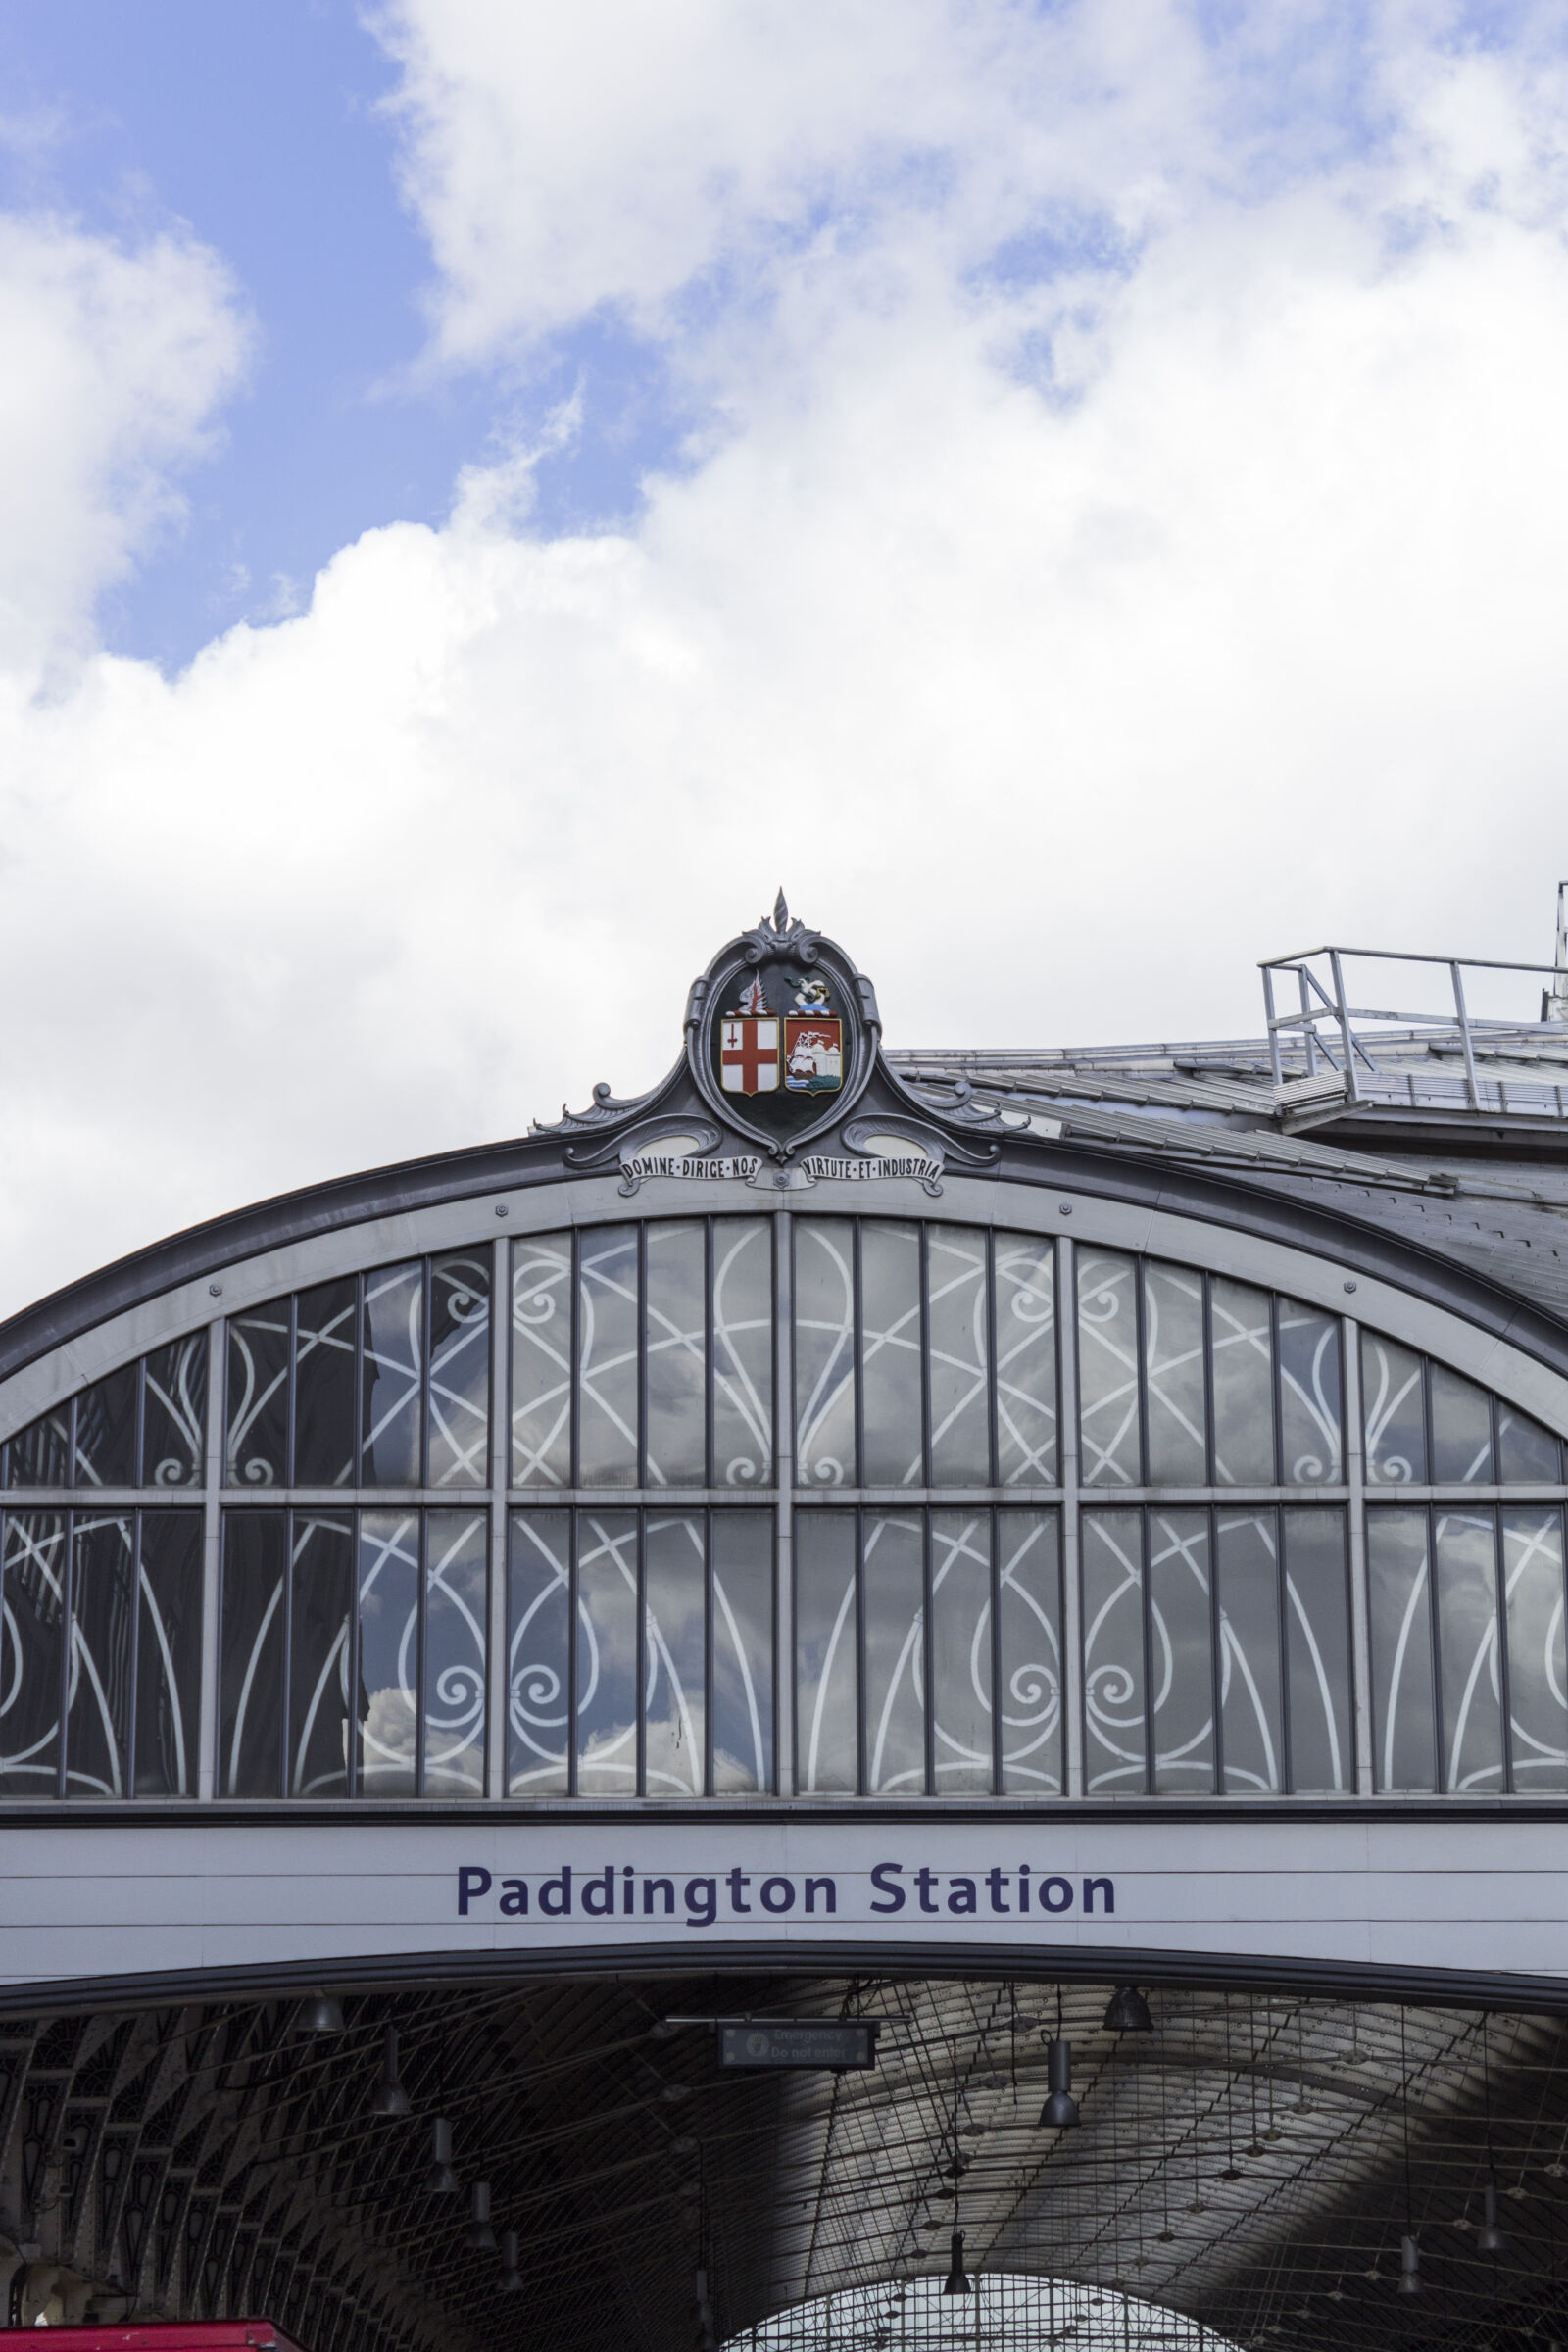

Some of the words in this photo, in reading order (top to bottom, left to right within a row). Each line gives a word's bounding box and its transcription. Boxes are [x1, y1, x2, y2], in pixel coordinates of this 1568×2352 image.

[622, 1157, 674, 1178] DOMINE
[682, 1159, 725, 1178] DIRIGE
[732, 1157, 758, 1176] NOS
[802, 1157, 852, 1178] VIRTUTE
[858, 1160, 872, 1179] ET
[878, 1157, 941, 1180] INDUSTRIA
[457, 1865, 837, 1927] Paddington
[870, 1862, 1115, 1914] Station
[773, 2030, 843, 2043] Emergency
[771, 2047, 788, 2058] Do
[791, 2046, 812, 2058] not
[814, 2046, 847, 2058] enter
